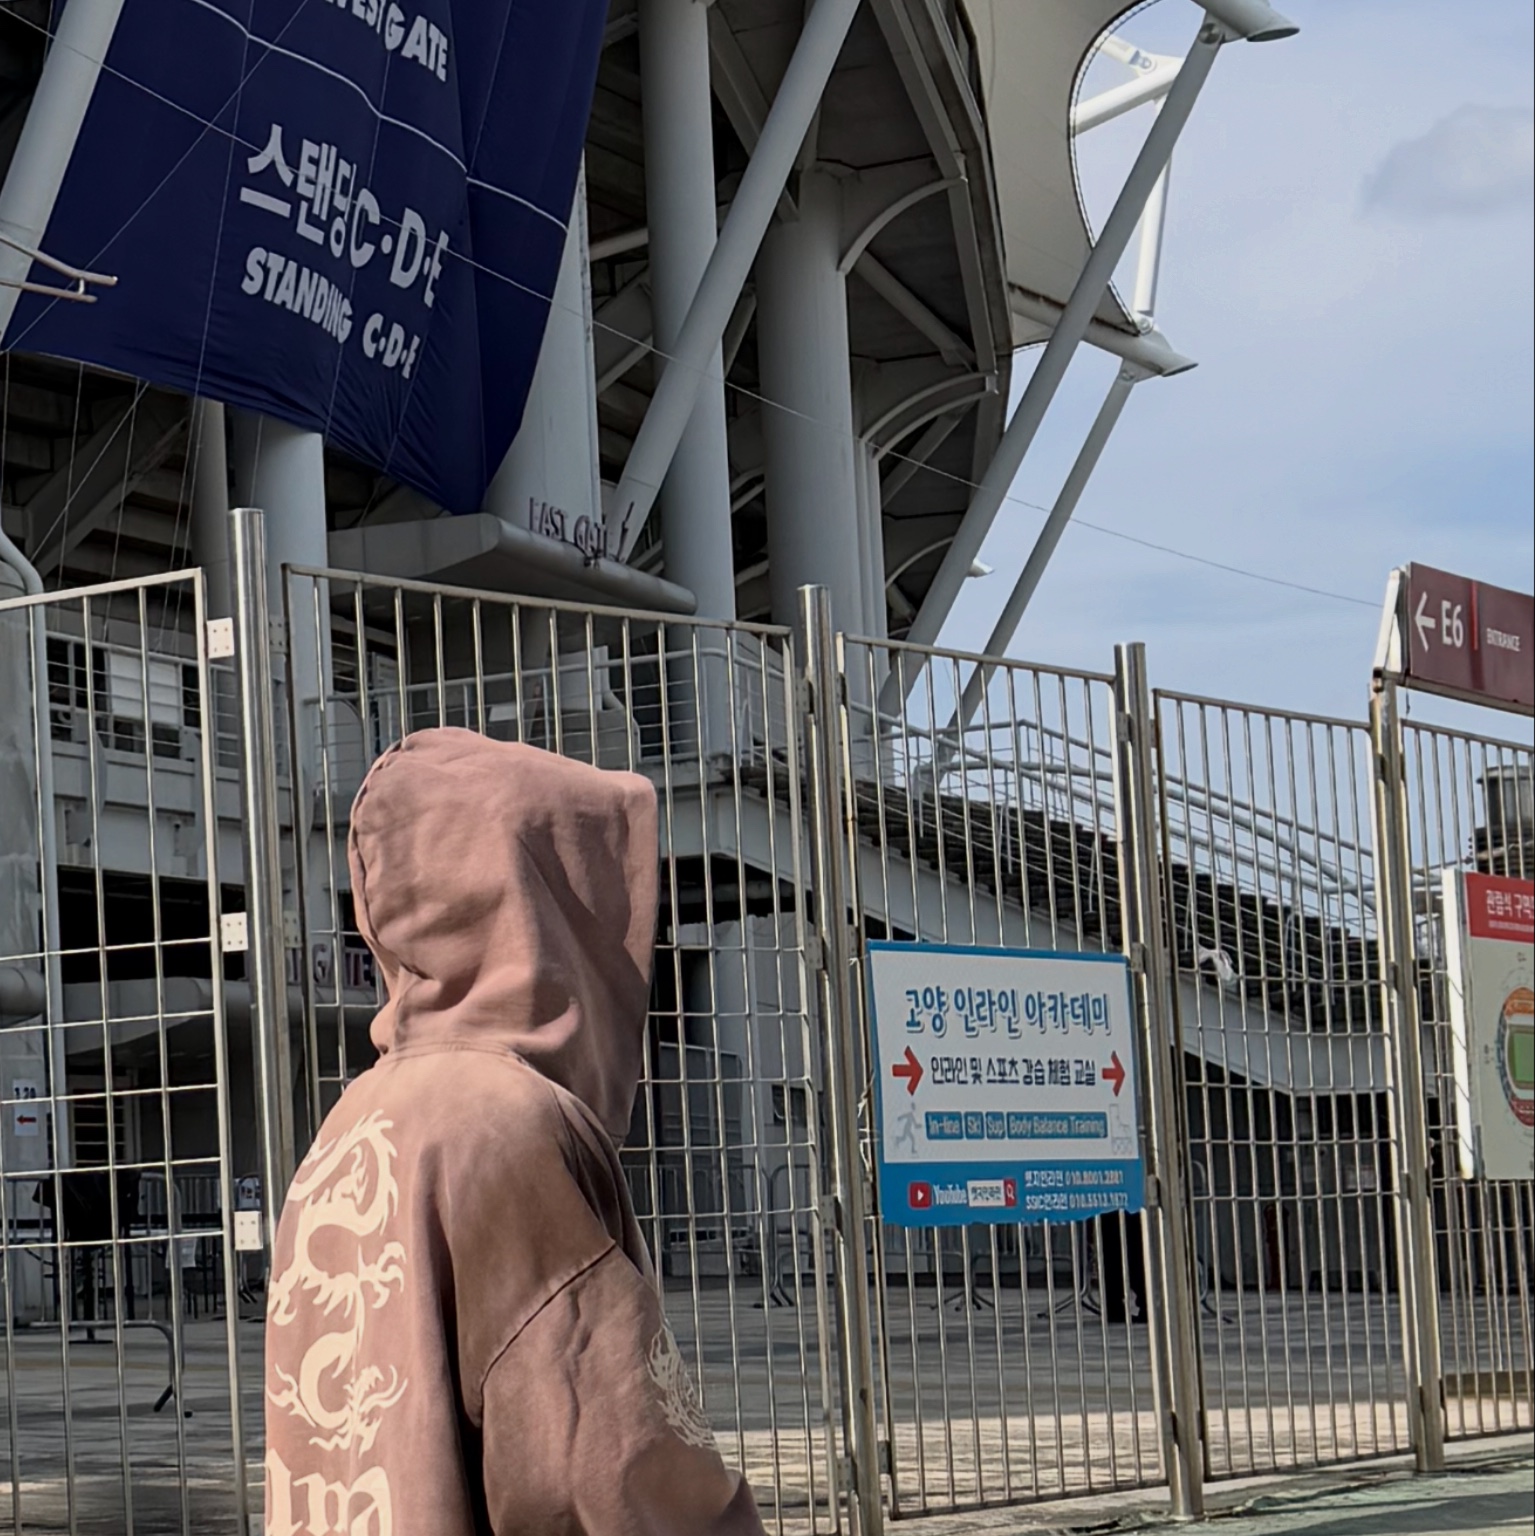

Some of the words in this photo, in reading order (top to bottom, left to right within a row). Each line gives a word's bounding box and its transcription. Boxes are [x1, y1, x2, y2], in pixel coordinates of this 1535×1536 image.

[384, 2, 448, 83] GATE
[241, 246, 353, 344] STANDING
[1441, 600, 1464, 648] E6
[905, 986, 947, 1036] 고양
[954, 987, 1021, 1038] 인라인
[1024, 991, 1111, 1036] 아카데미
[931, 1056, 968, 1084] 인라인
[971, 1058, 983, 1084] 및
[987, 1057, 1020, 1084] 스포츠
[1022, 1059, 1045, 1085] 강습
[1048, 1058, 1071, 1085] 체험
[1074, 1059, 1096, 1086] 교실
[1009, 1115, 1032, 1136] Body
[1034, 1115, 1067, 1135] Balance
[1069, 1115, 1105, 1137] Training
[932, 1183, 968, 1205] YouTube
